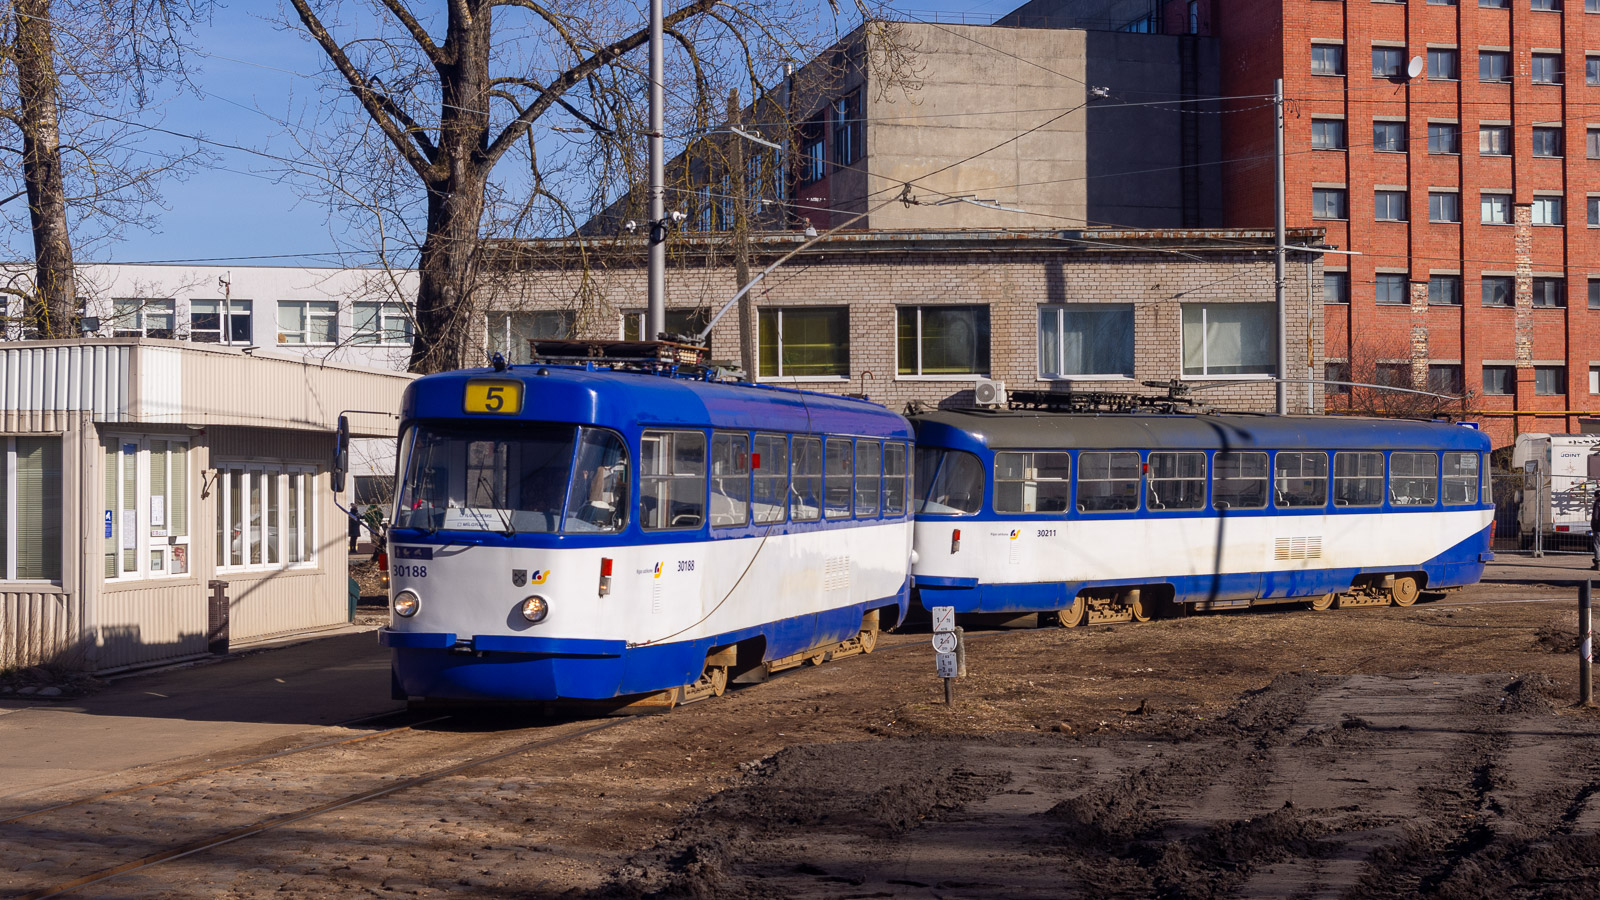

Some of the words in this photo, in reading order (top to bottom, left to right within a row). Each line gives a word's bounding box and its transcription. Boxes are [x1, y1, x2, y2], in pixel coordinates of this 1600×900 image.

[485, 387, 504, 412] 5
[1037, 529, 1056, 537] 30211
[393, 564, 427, 578] 30188
[677, 560, 694, 571] 30188
